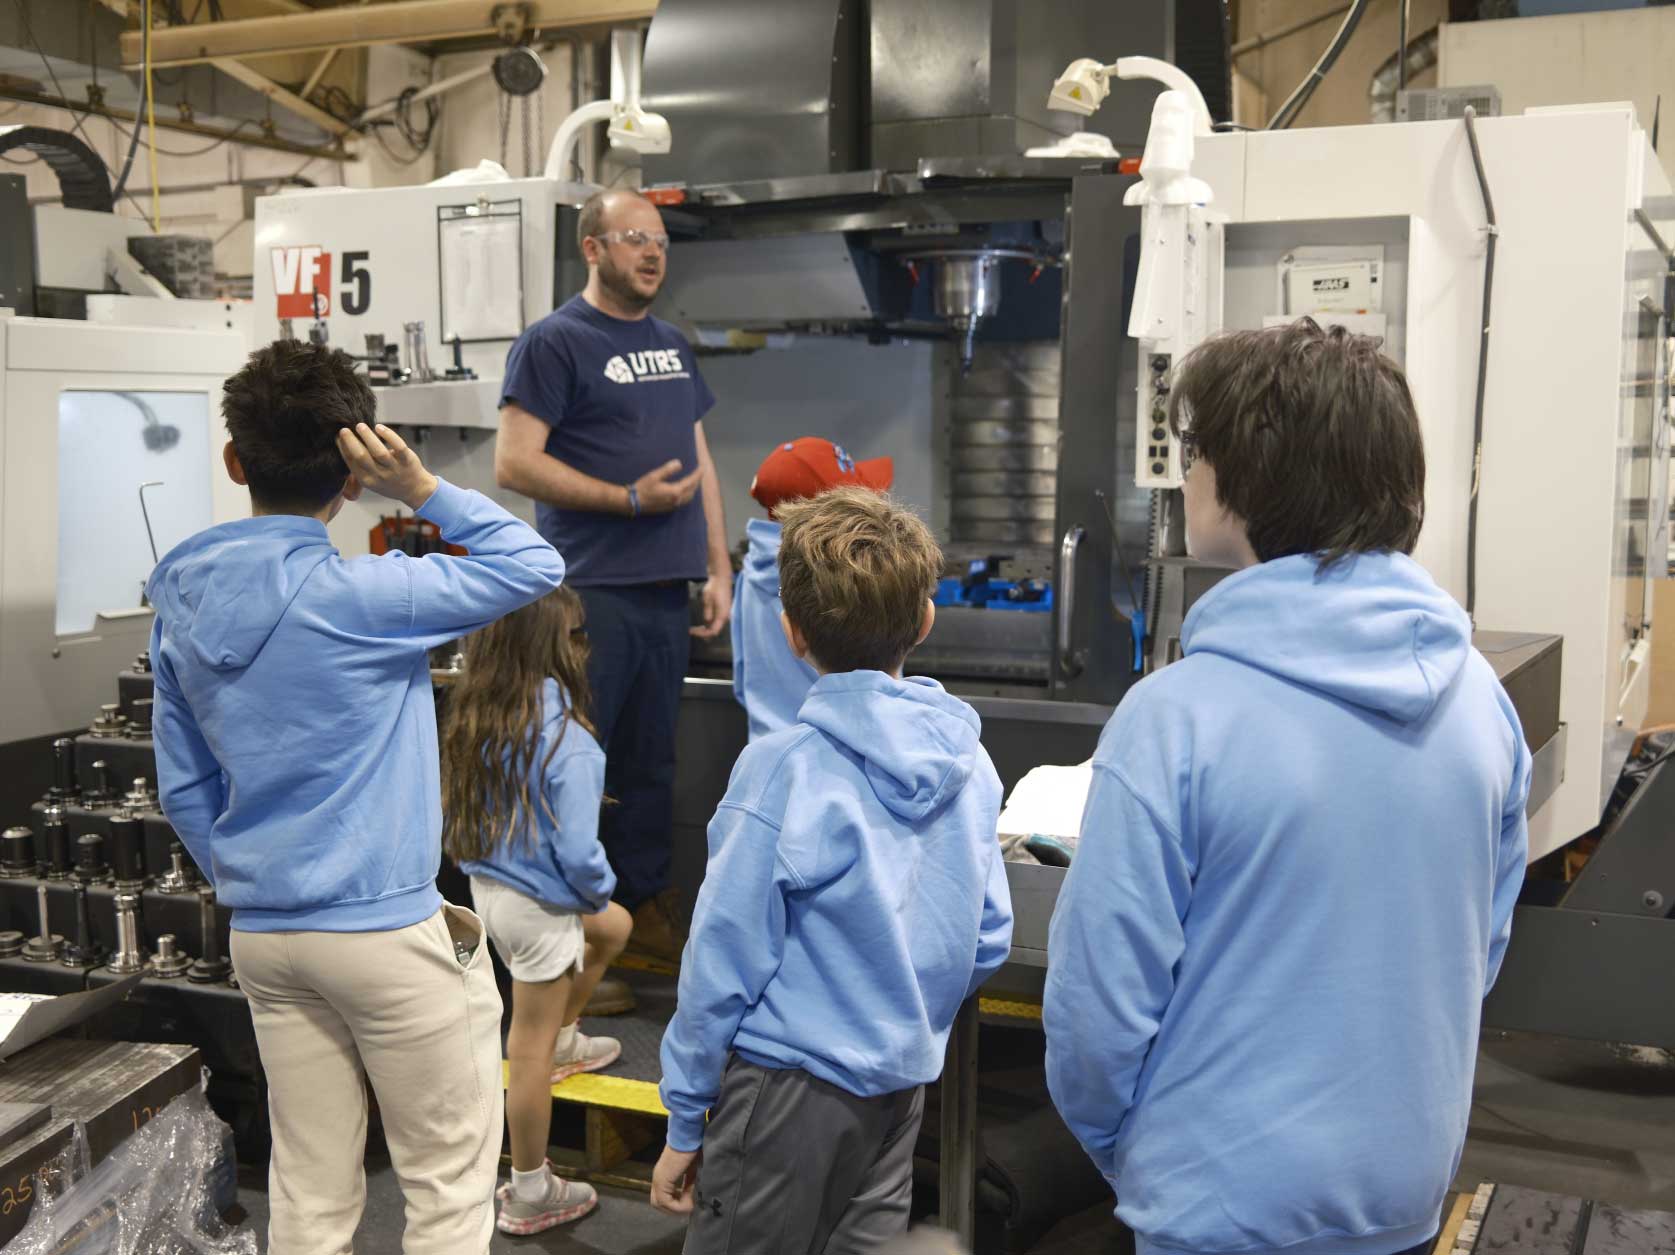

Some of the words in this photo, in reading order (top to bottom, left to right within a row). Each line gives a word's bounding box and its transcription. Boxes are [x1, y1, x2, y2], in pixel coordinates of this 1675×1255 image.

[271, 247, 321, 294] VF
[341, 251, 371, 315] 5
[627, 348, 683, 375] UTRS
